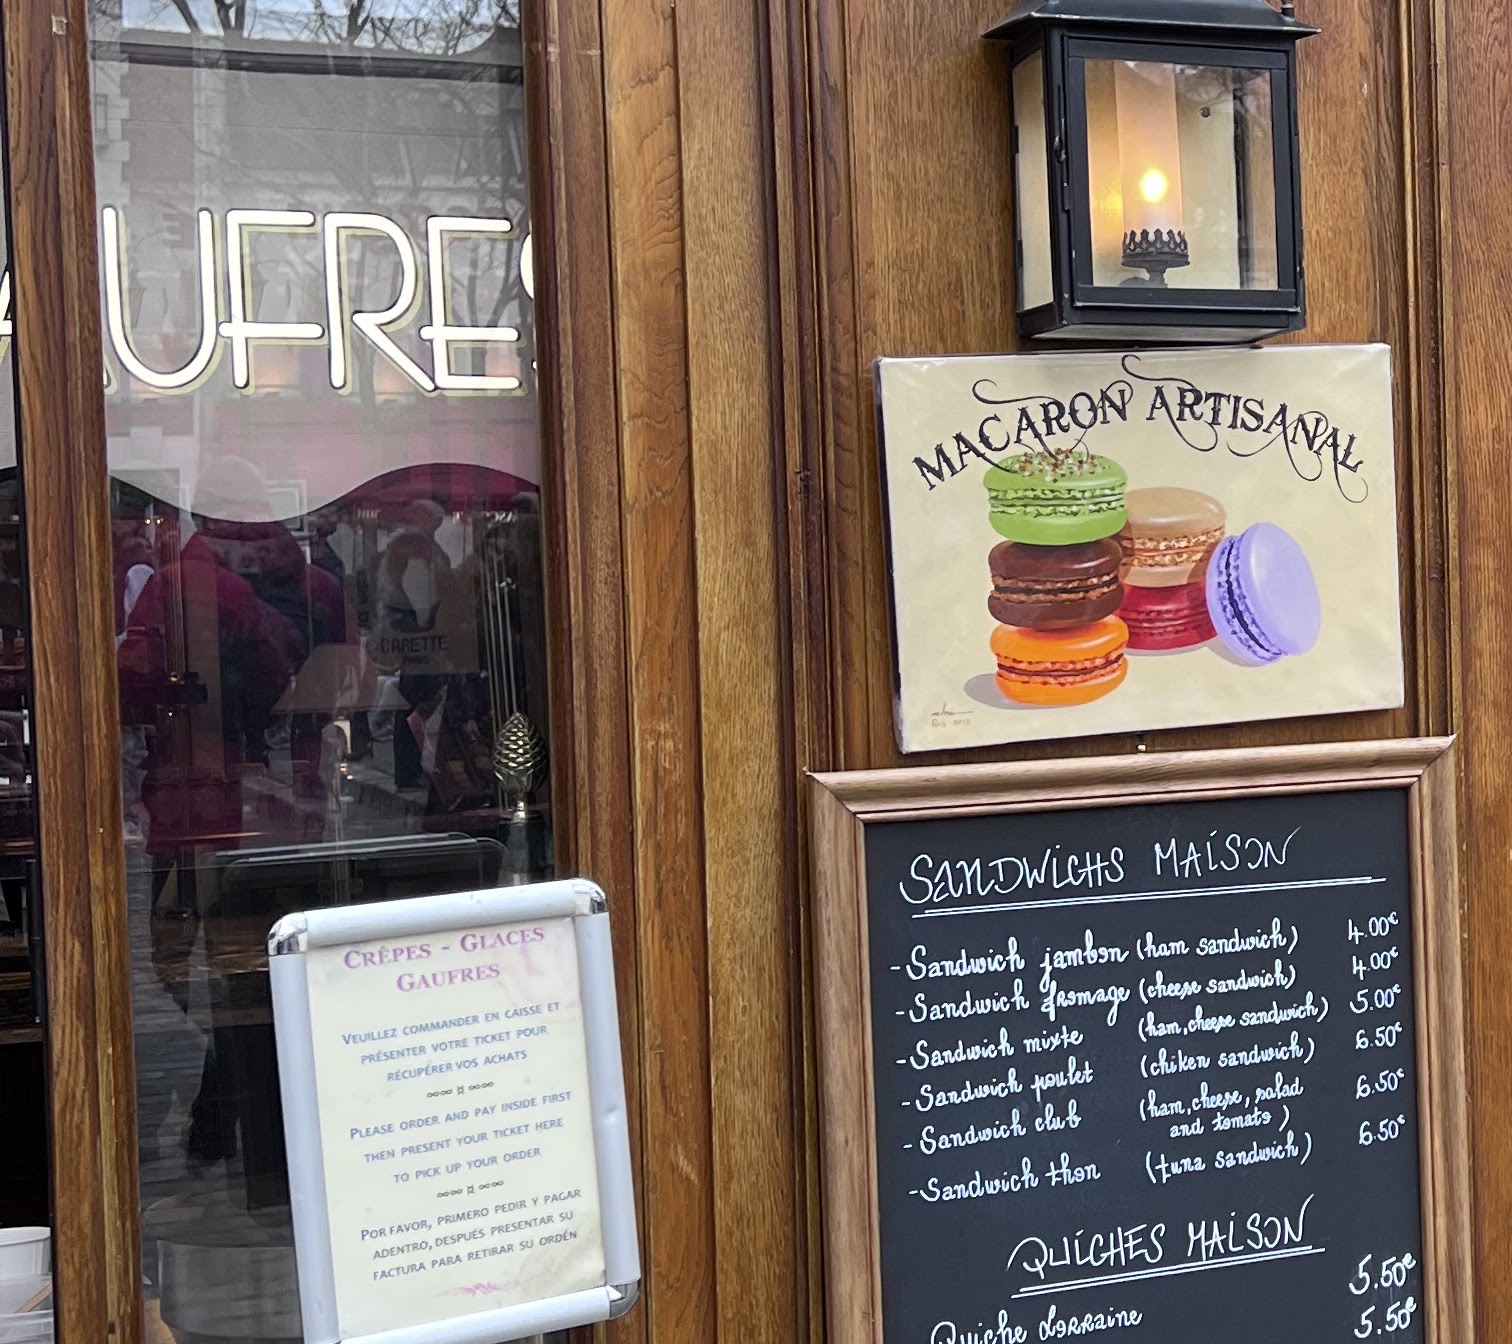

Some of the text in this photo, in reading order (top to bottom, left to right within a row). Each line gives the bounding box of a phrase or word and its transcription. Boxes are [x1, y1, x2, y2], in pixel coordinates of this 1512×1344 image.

[100, 205, 534, 393] UFRE
[912, 358, 1367, 499] MACARON ARTISANAL
[900, 828, 1301, 905] SANDWICHS MAISON
[343, 926, 545, 970] CRÊPES GLACES
[906, 937, 1025, 980] Sandwich
[1040, 929, 1128, 989] jambon
[1137, 932, 1189, 960] (ham
[1195, 917, 1299, 956] sandwich)
[395, 963, 501, 993] GAUFRES
[908, 979, 1030, 1023] Sandwich
[1040, 980, 1131, 1026] fromage
[1140, 974, 1201, 1004] (cheese
[1206, 964, 1296, 994] sandwich)
[341, 1001, 560, 1045] VEUILLEZ COMMANDER EN CAISSE ET
[361, 1025, 548, 1065] PRÉSENTER VOTRE TICKET POUR
[910, 1028, 1015, 1070] Sandwich
[1024, 1028, 1084, 1054] mixte
[1240, 992, 1329, 1027] sandwich)
[387, 1049, 527, 1082] RÉCUPÉRER VOS ACHATS
[915, 1069, 1022, 1111] Sandwich
[1031, 1056, 1093, 1088] poulet
[1219, 1038, 1315, 1068] sandwich)
[350, 1090, 572, 1139] PLEASE ORDER AND PAY INSIDE FIRST
[364, 1117, 564, 1163] THEN PRESENT YOUR TICKET HERE
[920, 1110, 1026, 1154] Sandwich
[1035, 1102, 1081, 1129] club
[1255, 1075, 1303, 1103] salad
[393, 1147, 541, 1184] TO PICK UP YOUR ORDER
[921, 1157, 1039, 1202] Sandwich
[1045, 1153, 1100, 1187] thon
[1145, 1150, 1205, 1184] (tuna
[1214, 1131, 1312, 1169] sandwich)
[361, 1227, 387, 1242] POR
[437, 1207, 490, 1226] PRIMERO
[494, 1199, 527, 1214] PEDIR
[531, 1196, 539, 1207] Y
[543, 1188, 582, 1205] PAGAR
[490, 1214, 555, 1237] PRESENTAR
[558, 1210, 574, 1223] SU
[1006, 1193, 1315, 1280] QUICHES MAISON
[373, 1258, 426, 1281] FACTURA
[431, 1254, 463, 1269] PARA
[467, 1243, 515, 1261] RETIRAR
[519, 1238, 534, 1251] SU
